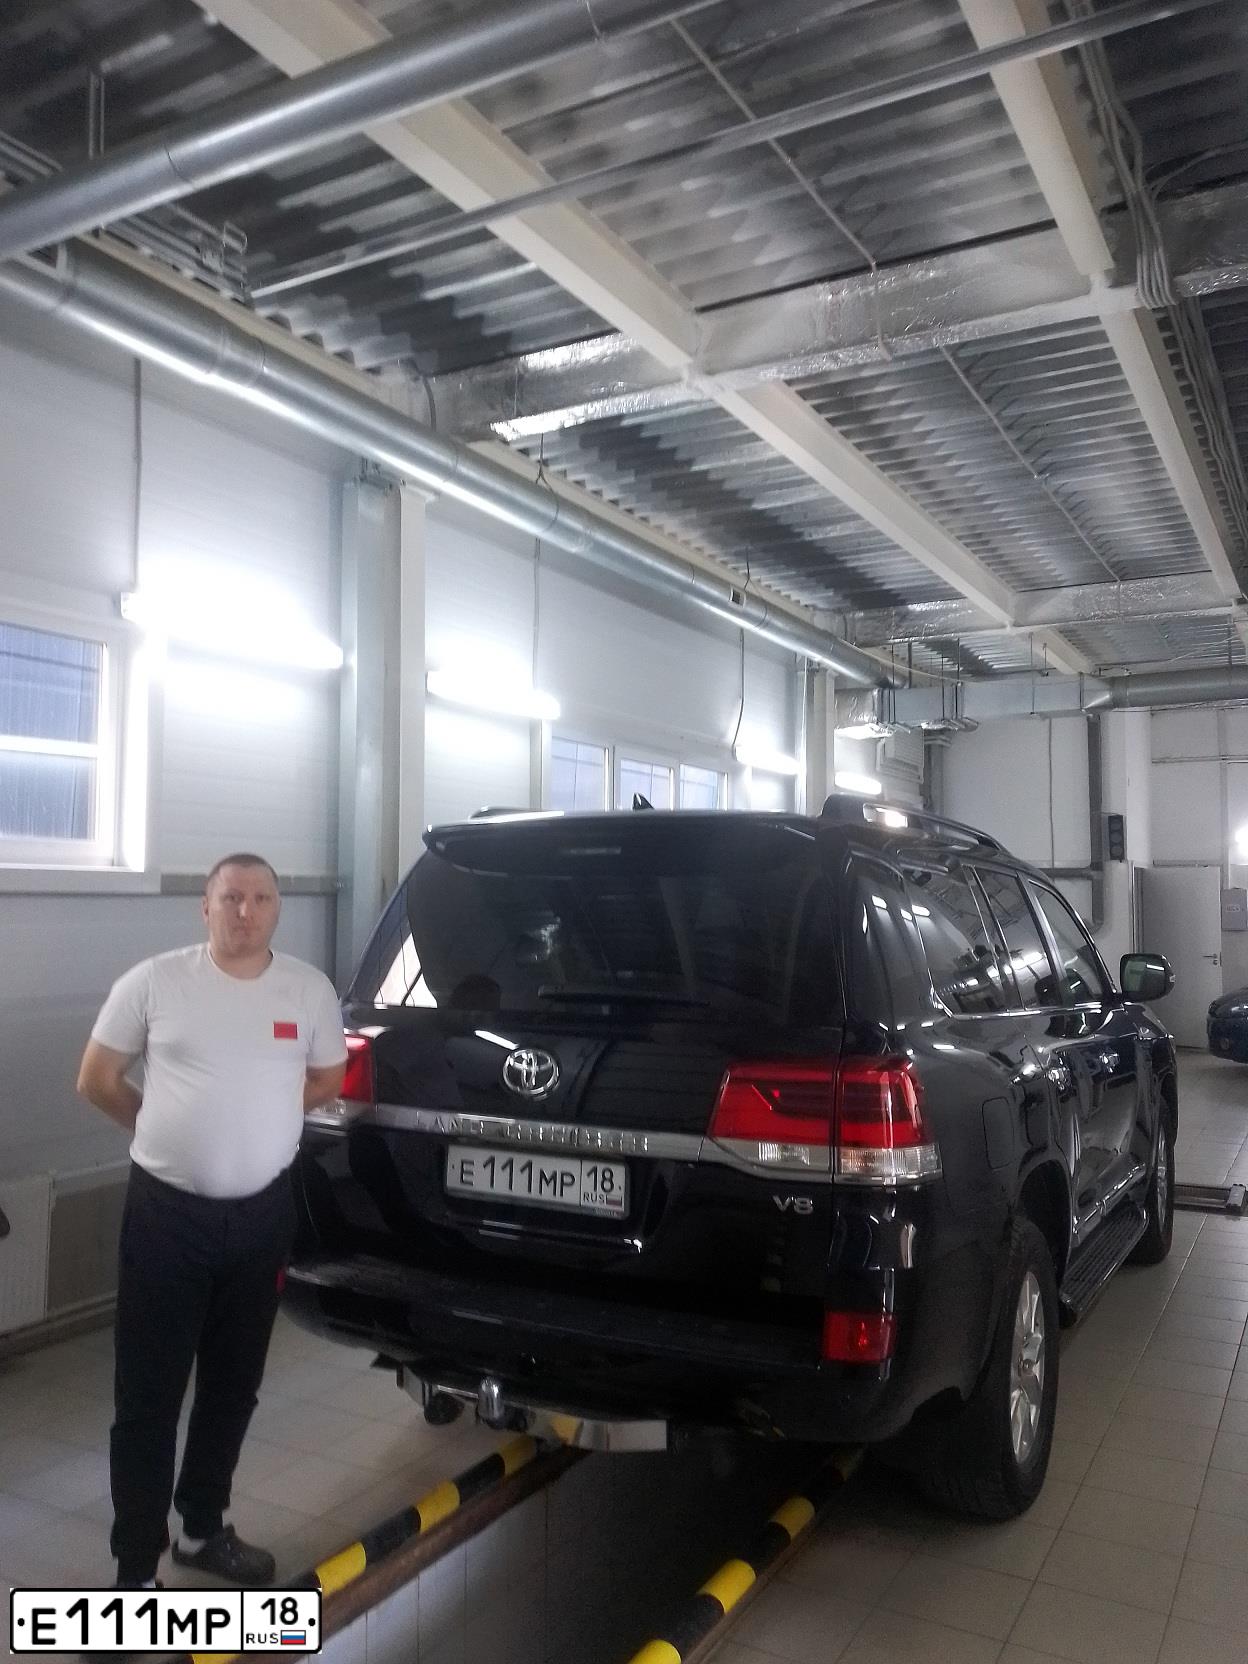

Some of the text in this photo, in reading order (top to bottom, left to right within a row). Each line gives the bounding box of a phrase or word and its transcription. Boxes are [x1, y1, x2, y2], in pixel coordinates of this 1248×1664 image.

[586, 1164, 615, 1193] 18
[583, 1192, 605, 1204] RUS
[773, 1195, 814, 1215] V8
